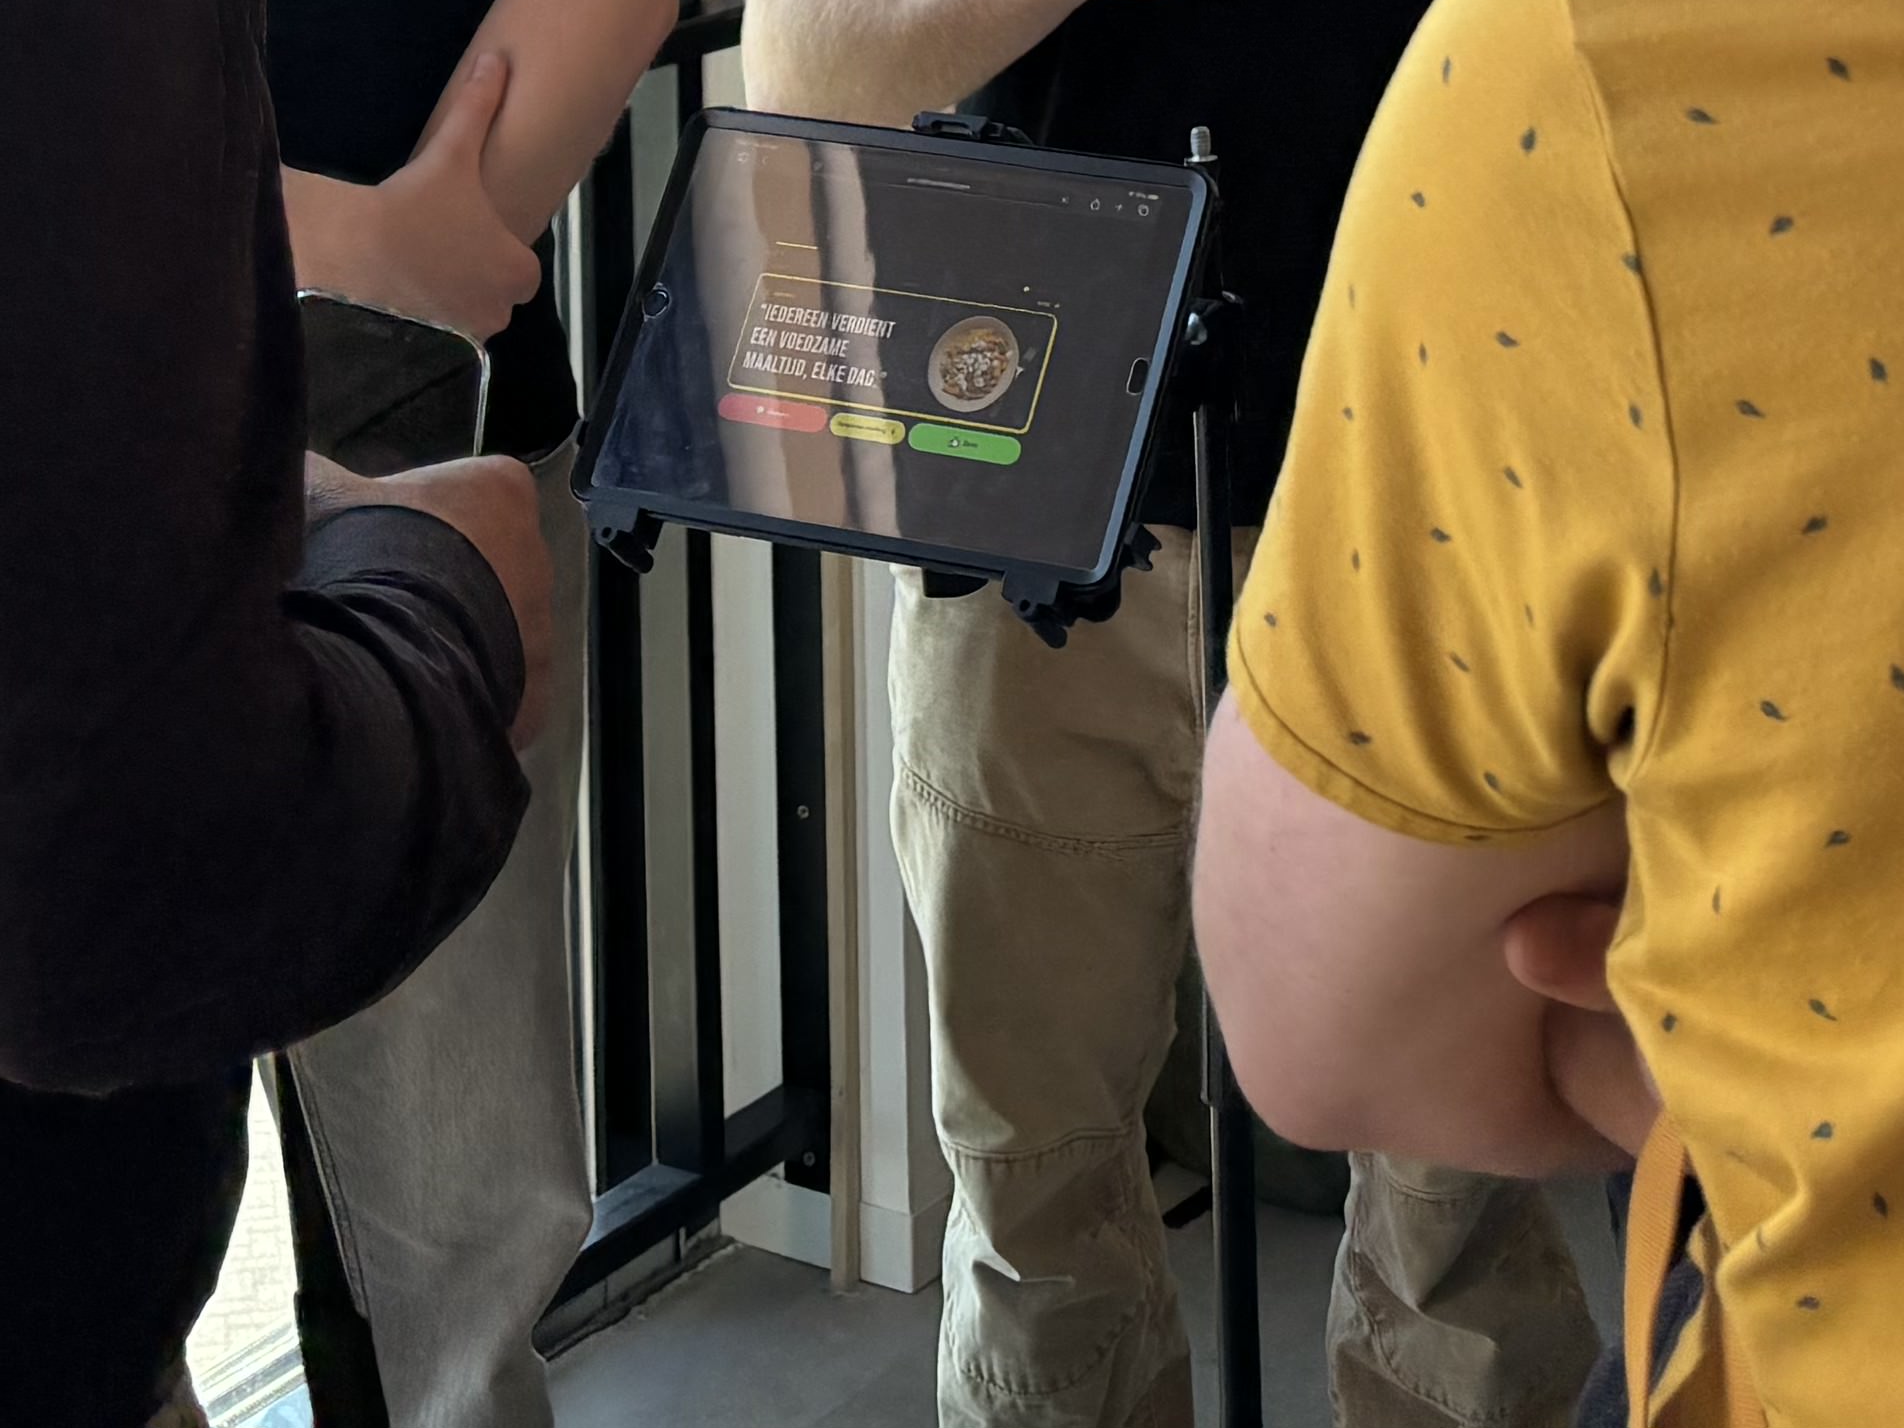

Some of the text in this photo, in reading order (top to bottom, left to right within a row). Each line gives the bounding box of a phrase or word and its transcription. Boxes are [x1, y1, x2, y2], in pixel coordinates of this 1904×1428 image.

[831, 312, 896, 339] VERDIENT
[750, 326, 850, 358] EEN VOEDZAME
[742, 350, 807, 381] MAALTIJD,
[811, 361, 846, 384] ELKE
